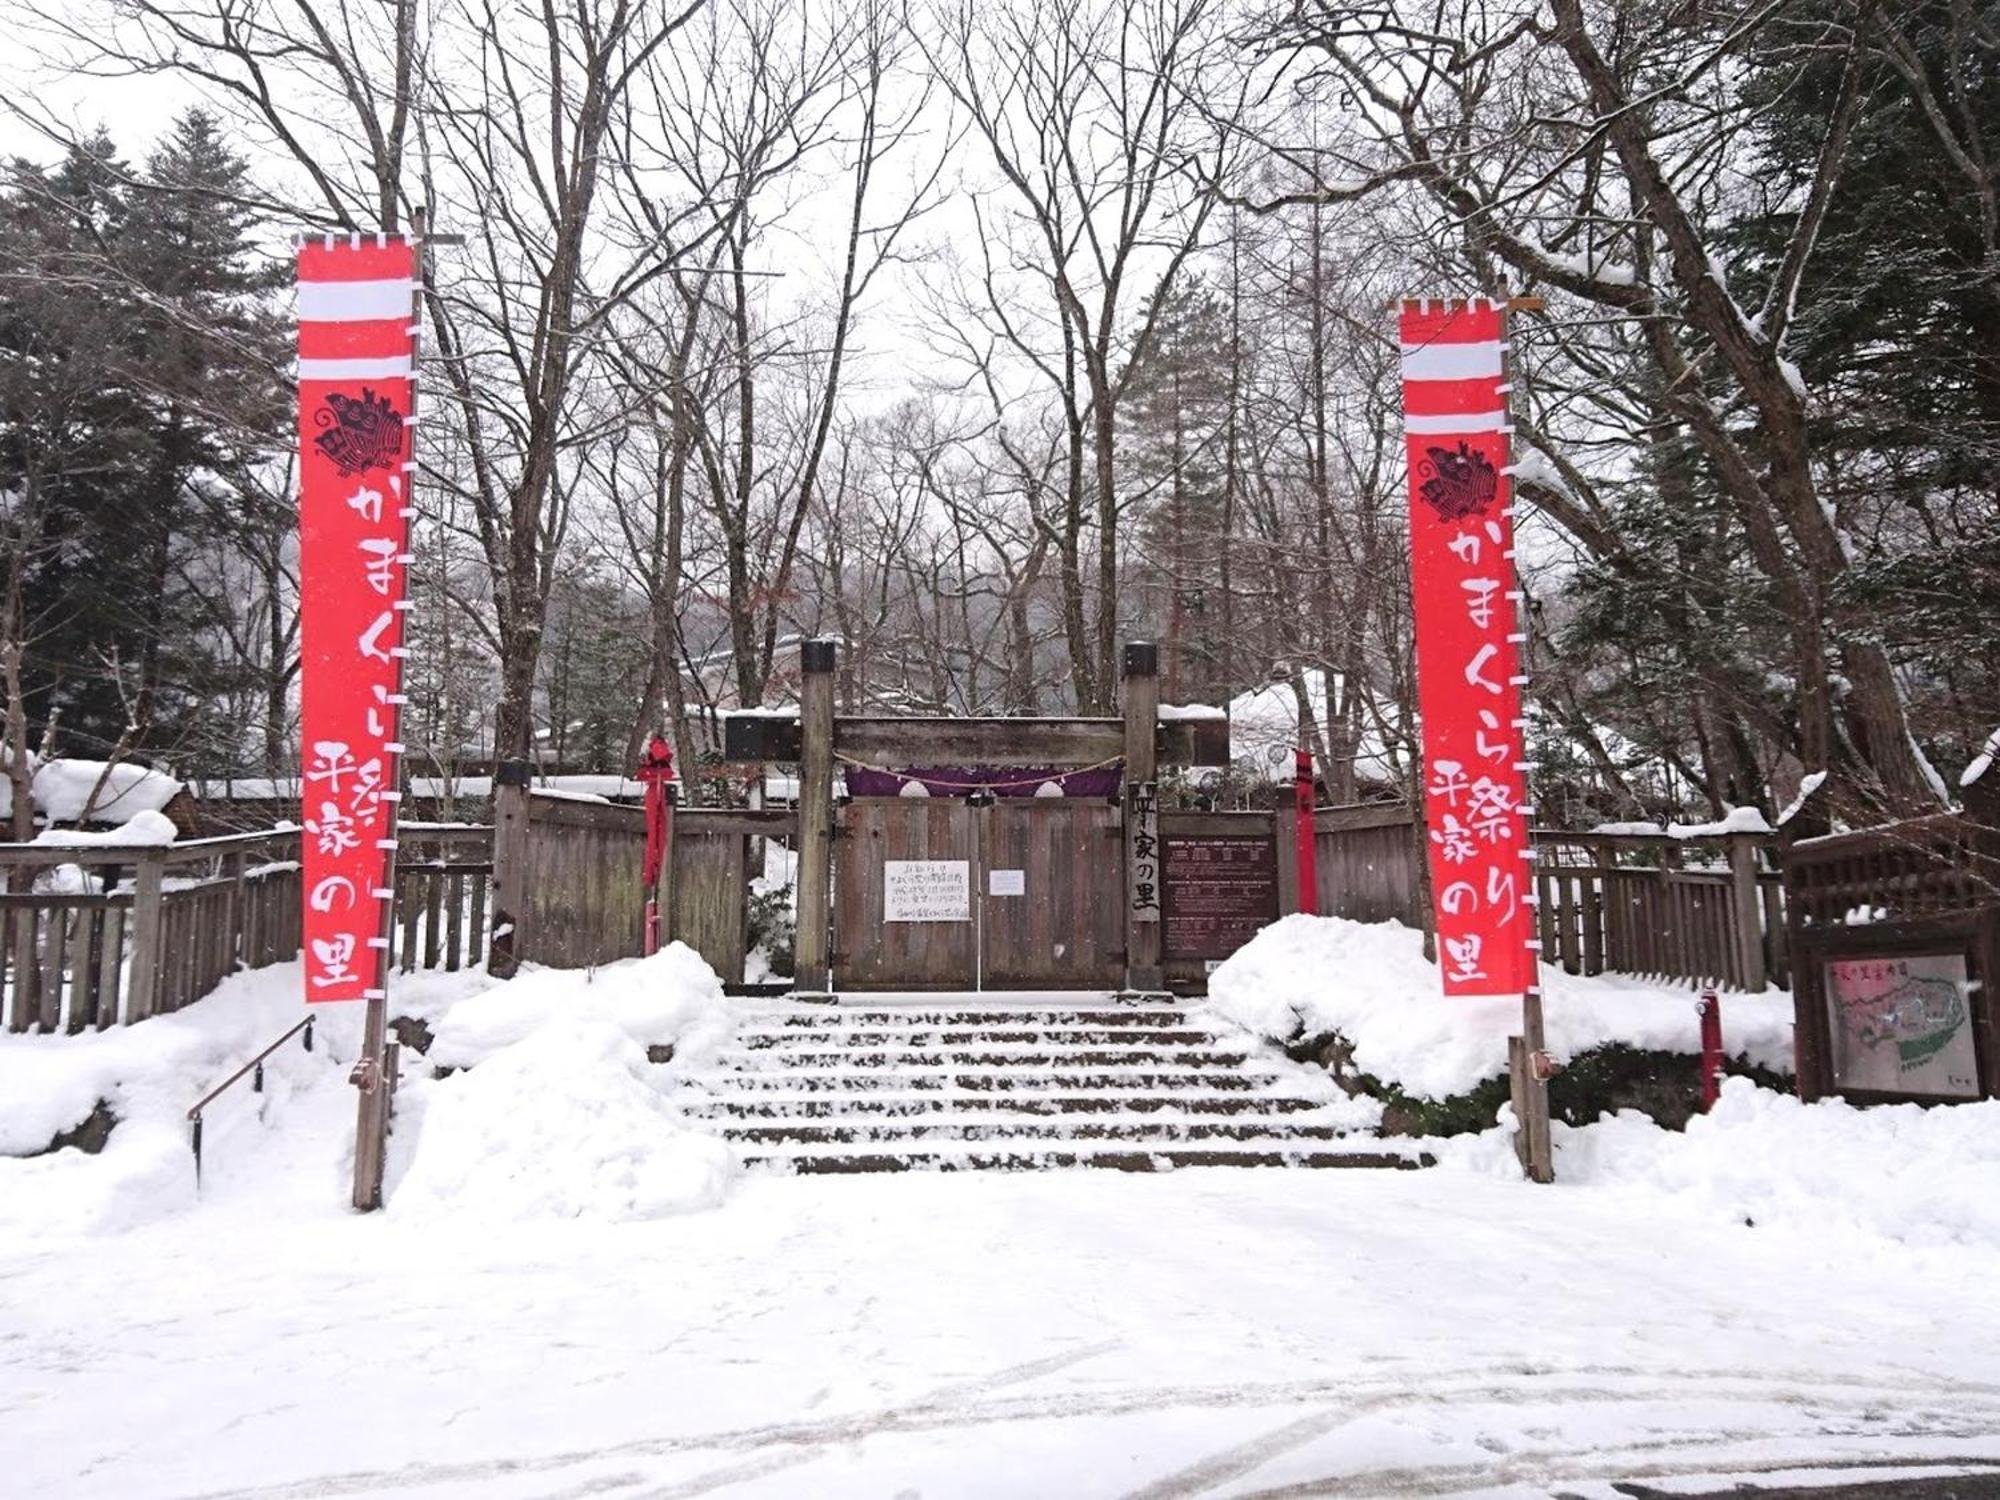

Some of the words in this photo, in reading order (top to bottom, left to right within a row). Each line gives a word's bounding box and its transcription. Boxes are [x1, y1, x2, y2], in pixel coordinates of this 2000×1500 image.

[1447, 521, 1519, 928] かまくら祭り
[304, 740, 361, 988] 平家の里
[1132, 795, 1159, 910] 平家の里
[1428, 760, 1488, 983] 平家の里
